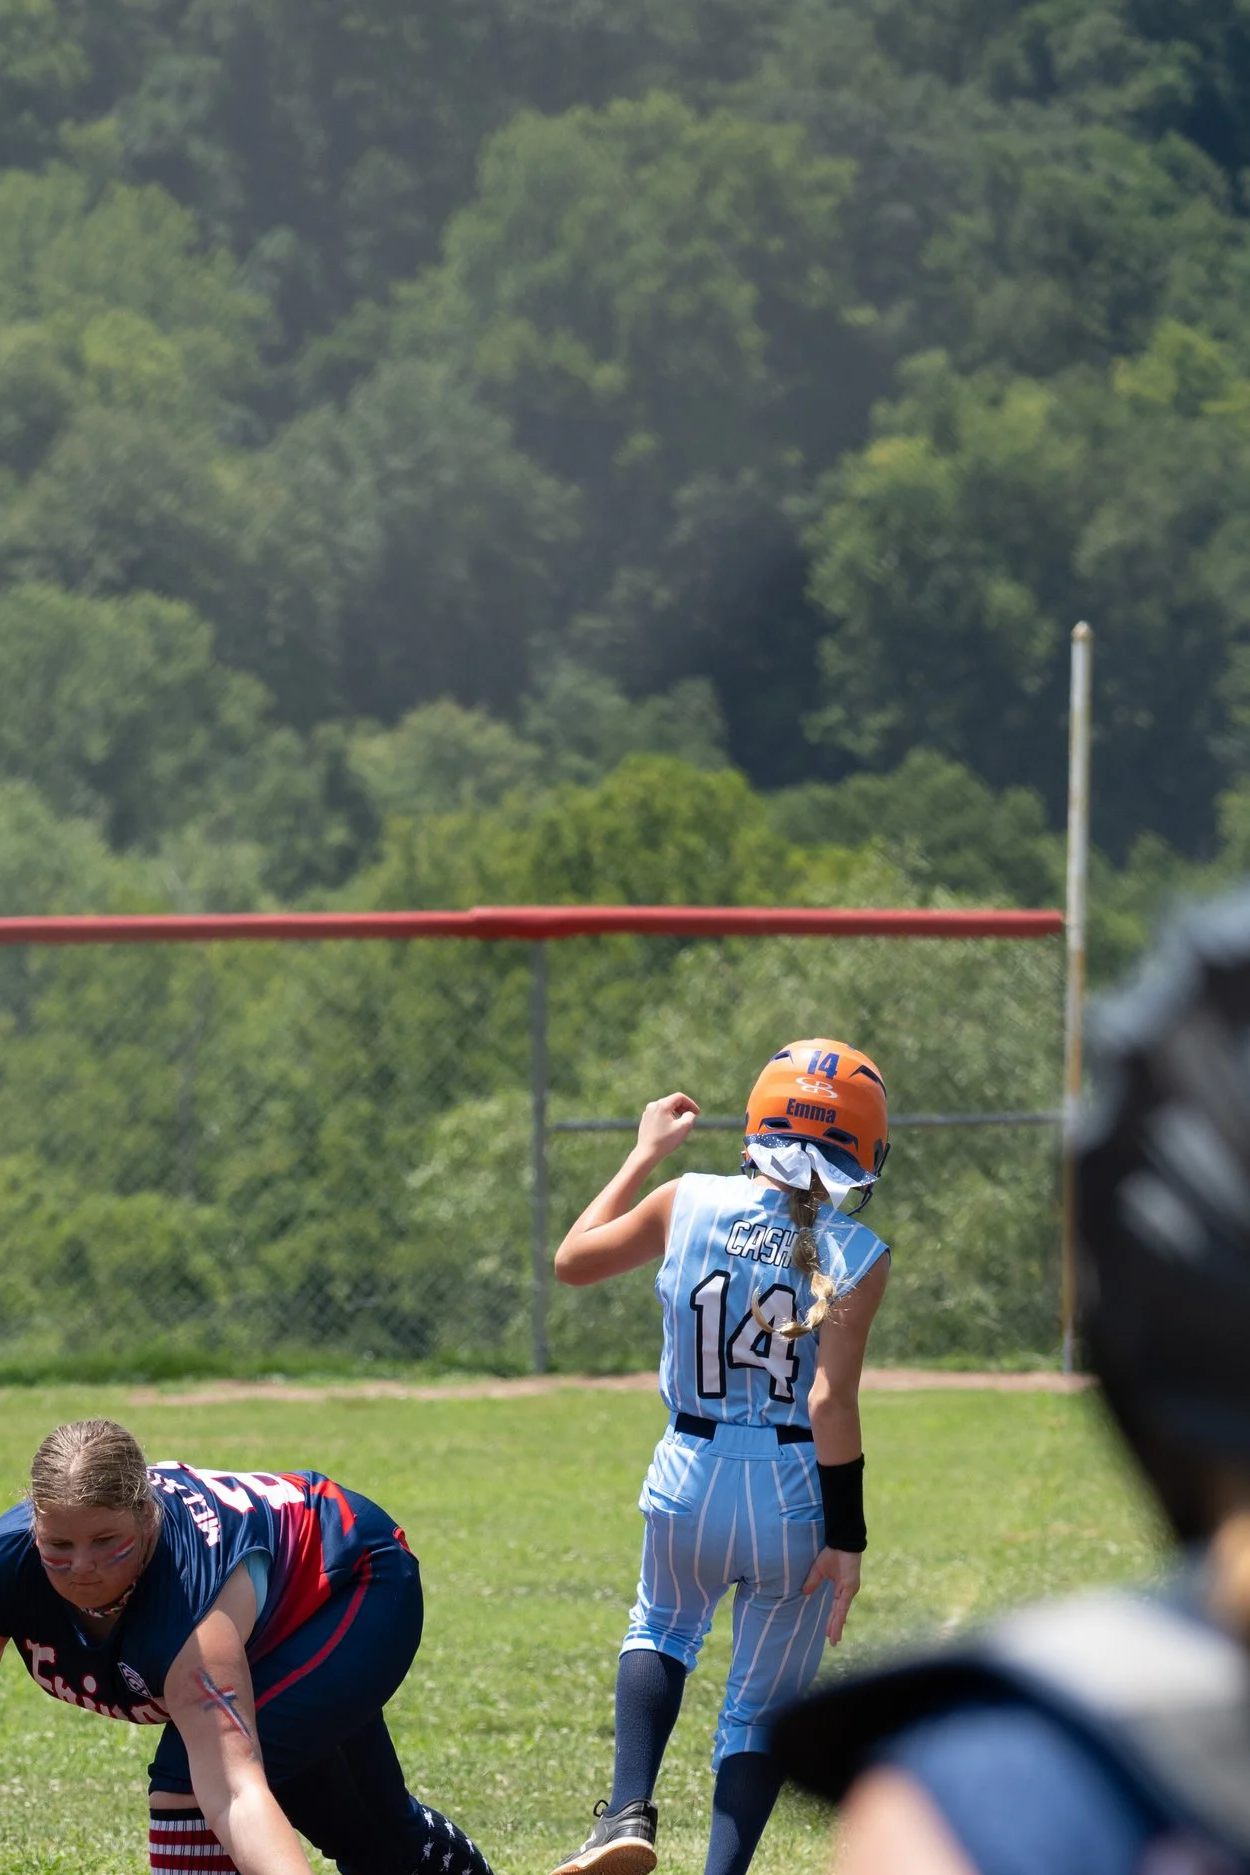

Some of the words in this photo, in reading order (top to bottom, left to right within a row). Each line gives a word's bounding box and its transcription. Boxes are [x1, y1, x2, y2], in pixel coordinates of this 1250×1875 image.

[807, 1050, 840, 1080] 14
[786, 1098, 837, 1124] Emma
[725, 1219, 799, 1269] CASH
[690, 1269, 800, 1404] 14
